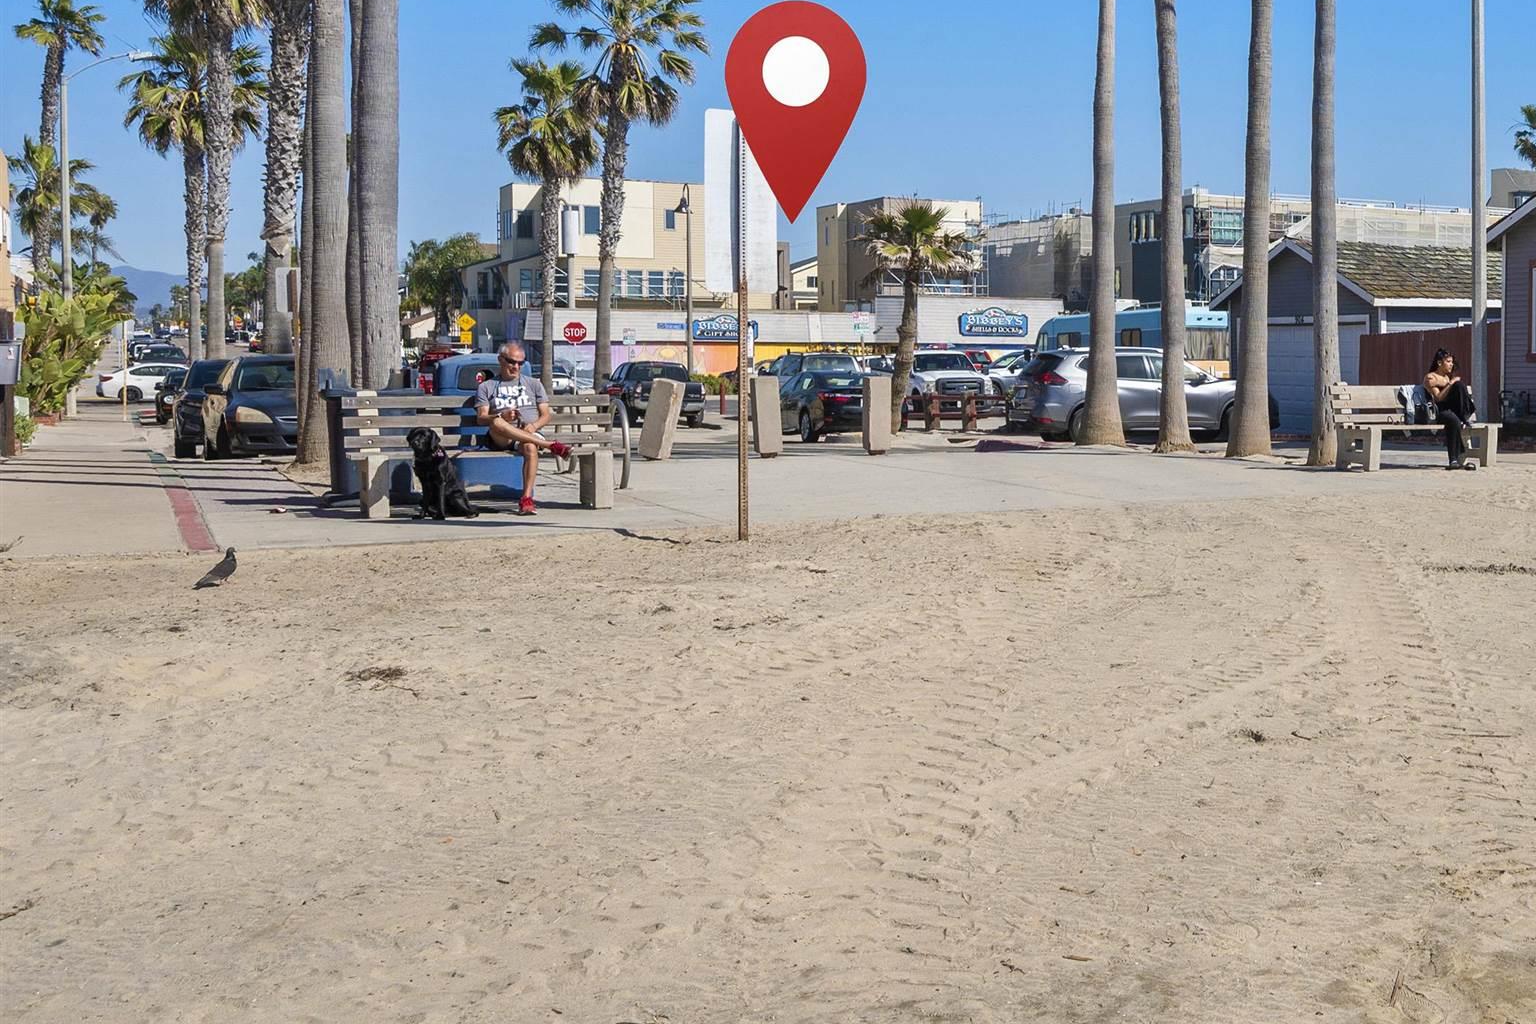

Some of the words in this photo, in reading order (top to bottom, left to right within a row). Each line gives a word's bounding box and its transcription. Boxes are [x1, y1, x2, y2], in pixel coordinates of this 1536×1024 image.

[967, 315, 1023, 325] BIBBEY'S
[564, 328, 586, 337] STOP
[498, 386, 526, 397] JUST
[495, 396, 517, 410] DO
